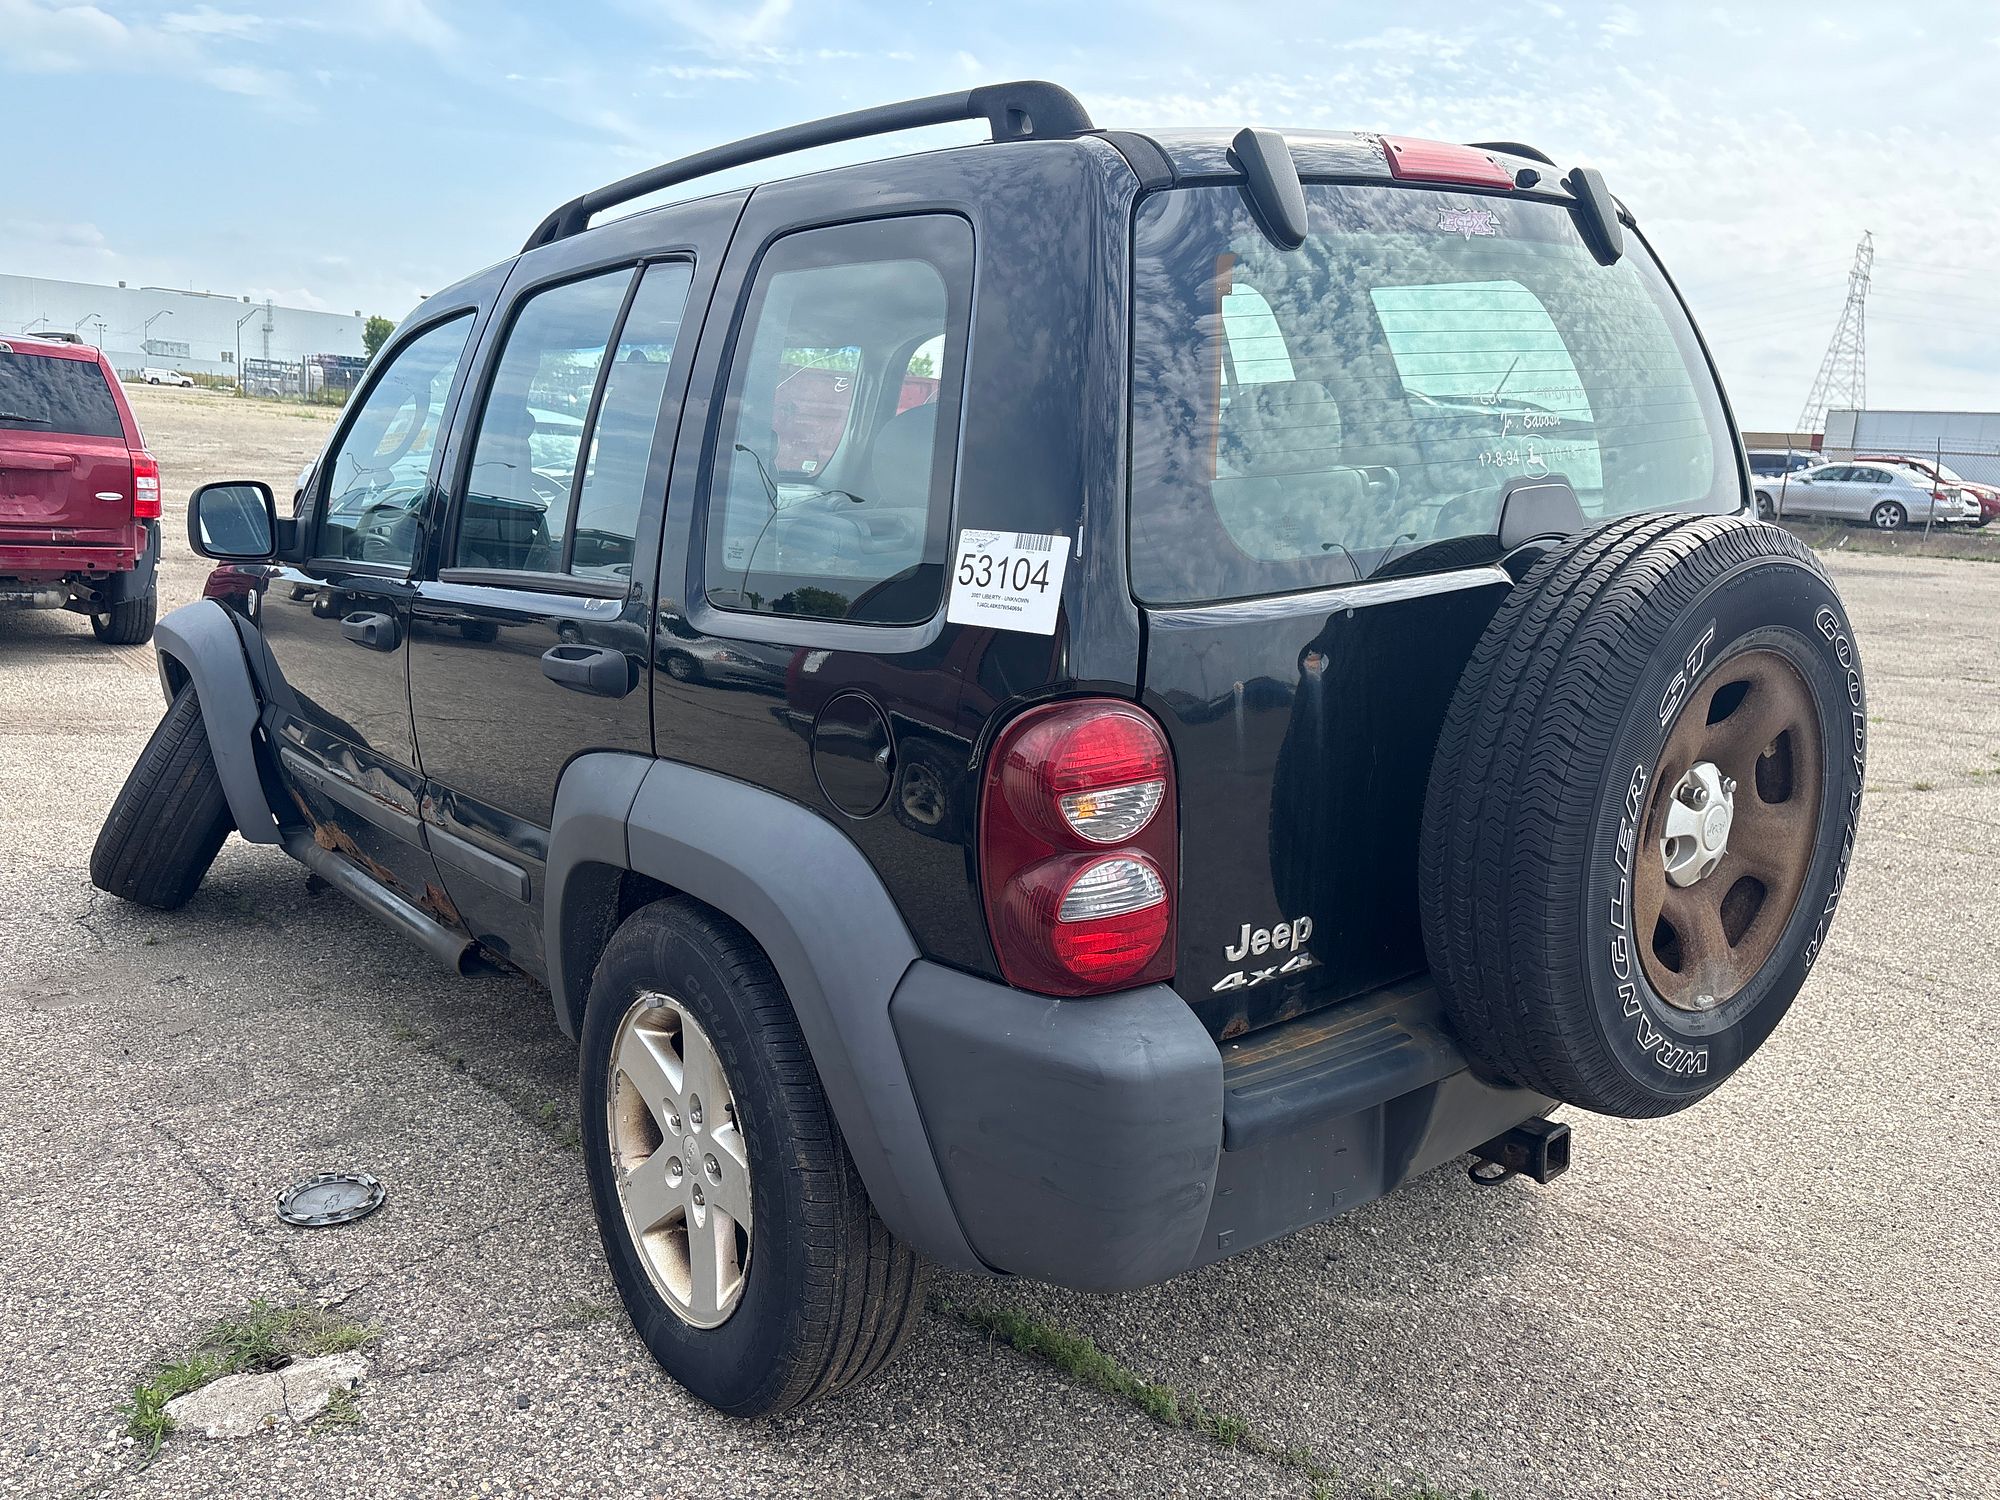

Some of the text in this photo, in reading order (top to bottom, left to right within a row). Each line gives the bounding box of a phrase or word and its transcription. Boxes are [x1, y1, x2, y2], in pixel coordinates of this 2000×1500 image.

[958, 553, 1050, 594] 53104
[981, 593, 1002, 601] LIBERTY
[1004, 596, 1030, 604] UNKNOWN
[1656, 623, 1717, 729] ST
[1805, 608, 1866, 970] GOODYEAR
[1225, 915, 1313, 962] Jeep
[1609, 763, 1708, 1077] WRANGLER
[1211, 952, 1313, 992] 4x4
[684, 973, 764, 1161] COURSER
